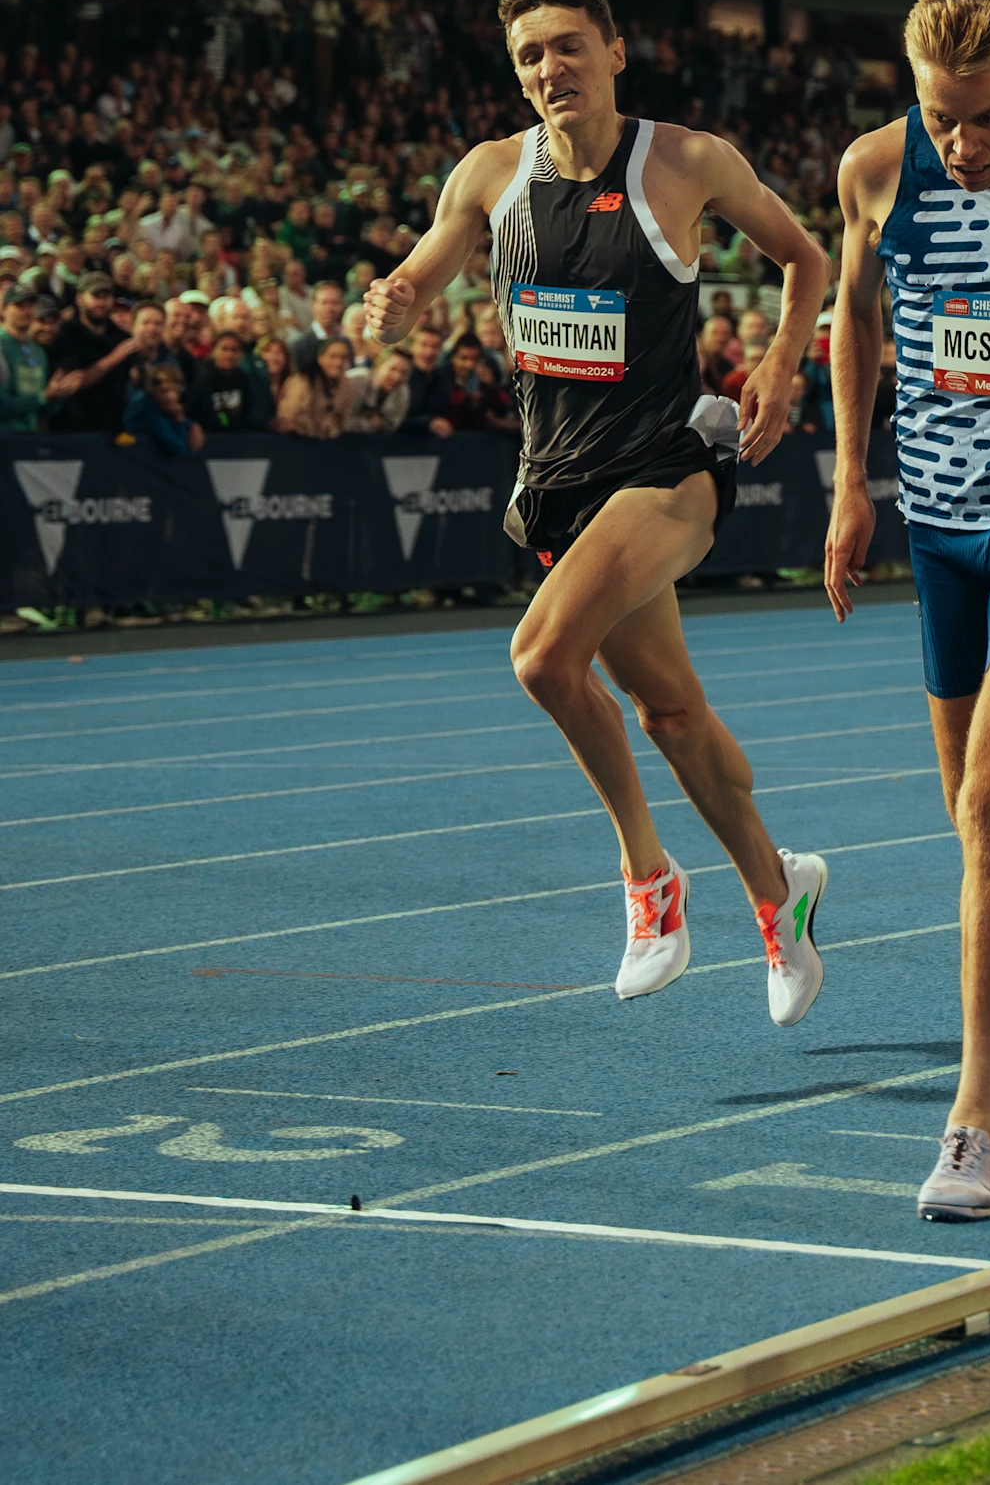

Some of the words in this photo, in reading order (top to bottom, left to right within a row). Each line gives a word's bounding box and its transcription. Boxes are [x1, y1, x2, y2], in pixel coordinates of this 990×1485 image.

[538, 291, 576, 304] CHEMIST
[538, 301, 575, 310] WAREHOUSE
[518, 316, 617, 351] WIGHTMAN
[543, 361, 615, 377] Melbourne2024
